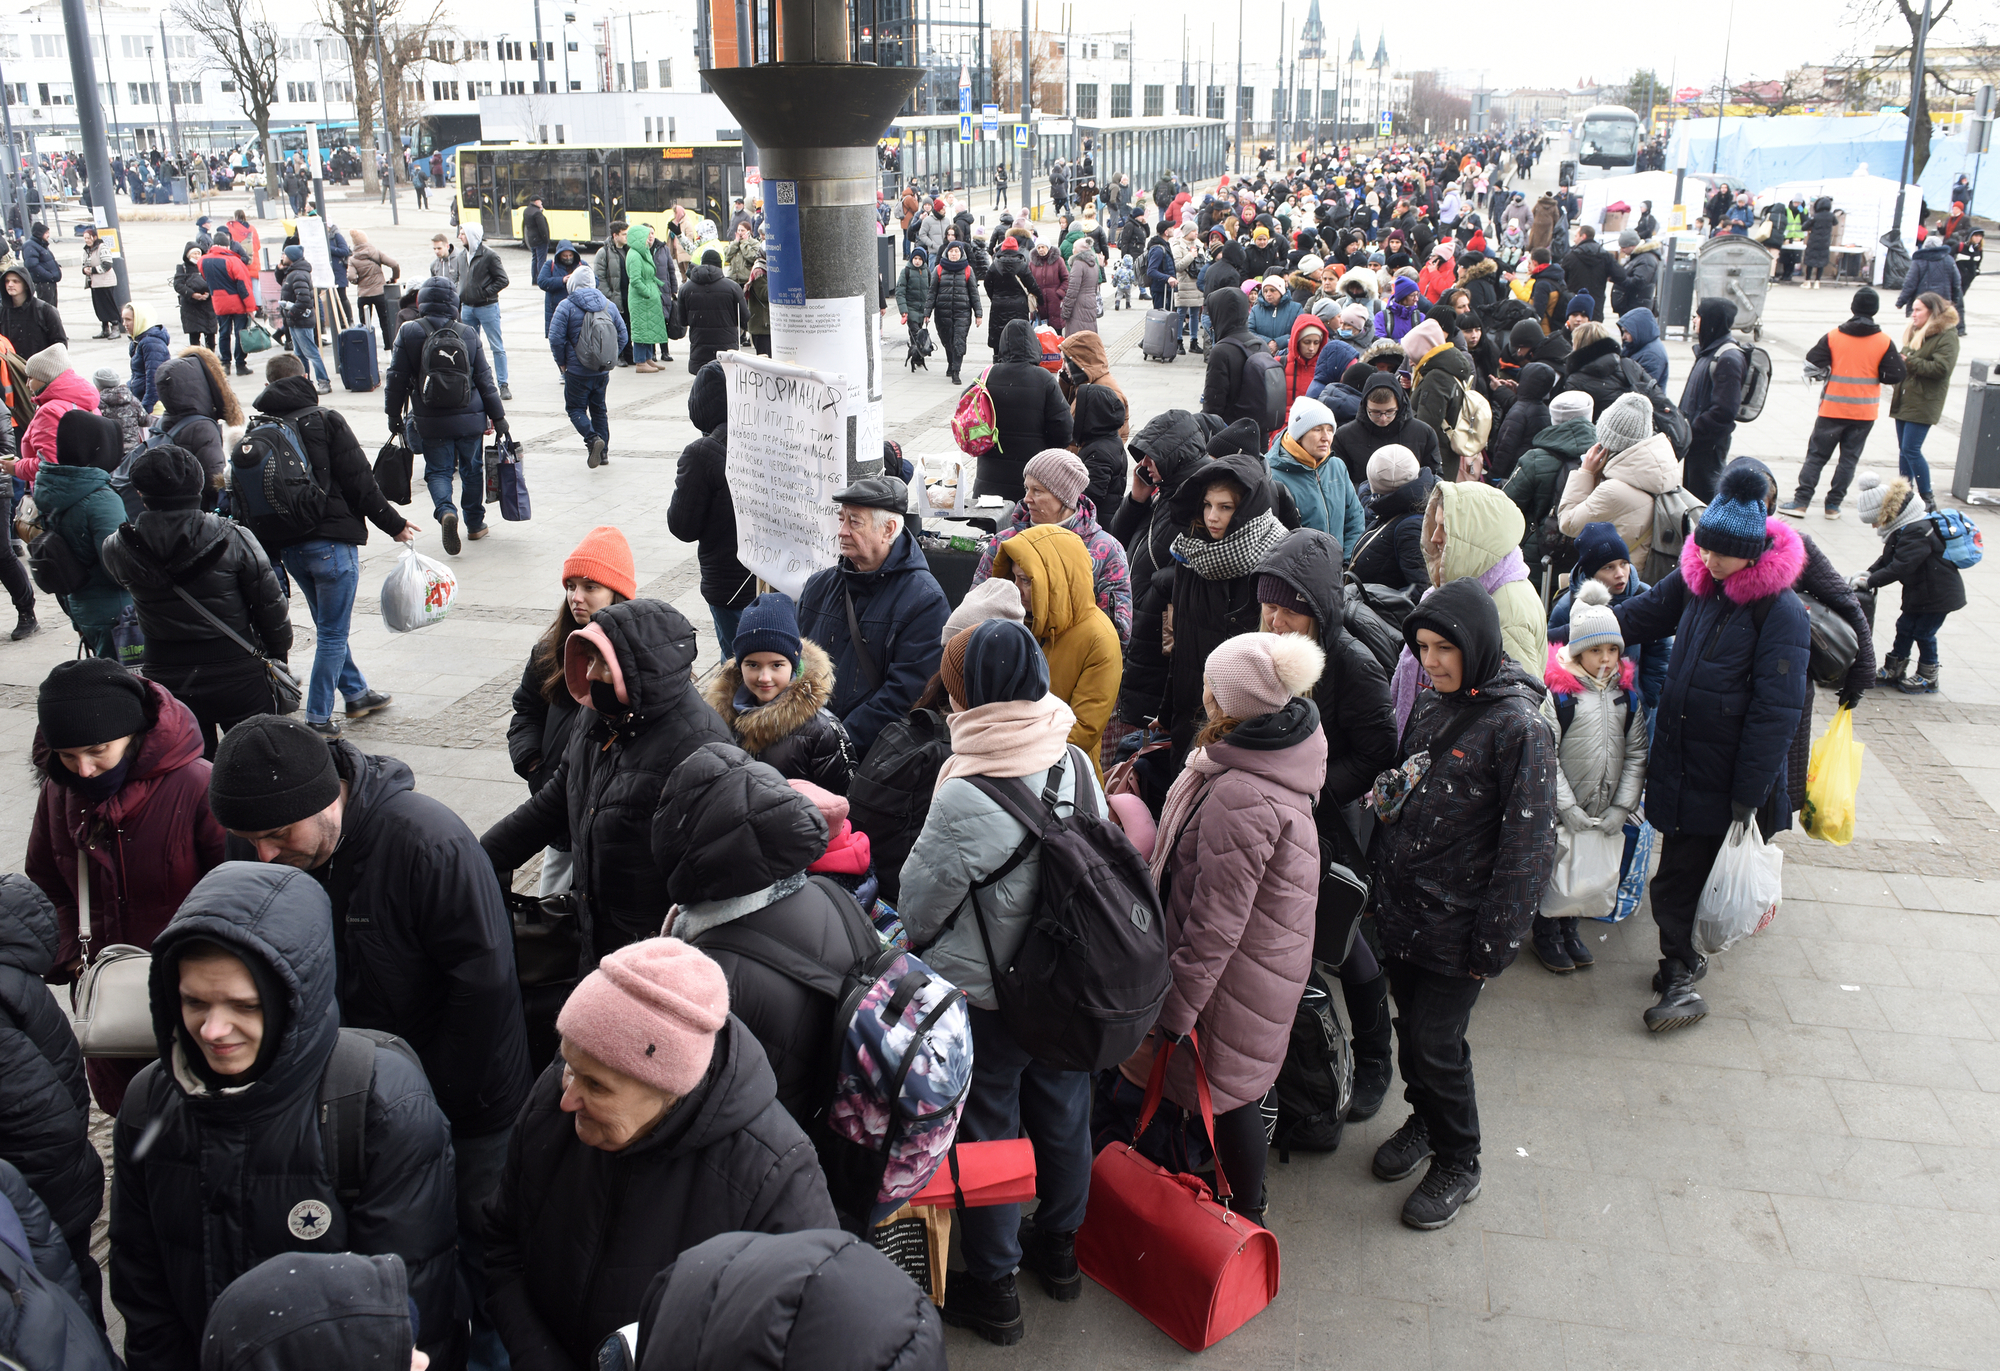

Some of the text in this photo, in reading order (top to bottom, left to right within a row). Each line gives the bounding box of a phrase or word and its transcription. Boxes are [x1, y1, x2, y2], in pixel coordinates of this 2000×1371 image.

[827, 472, 843, 484] 66
[804, 485, 815, 498] 67
[293, 1204, 326, 1217] CONVERSE
[295, 1227, 322, 1237] ALL STAR
